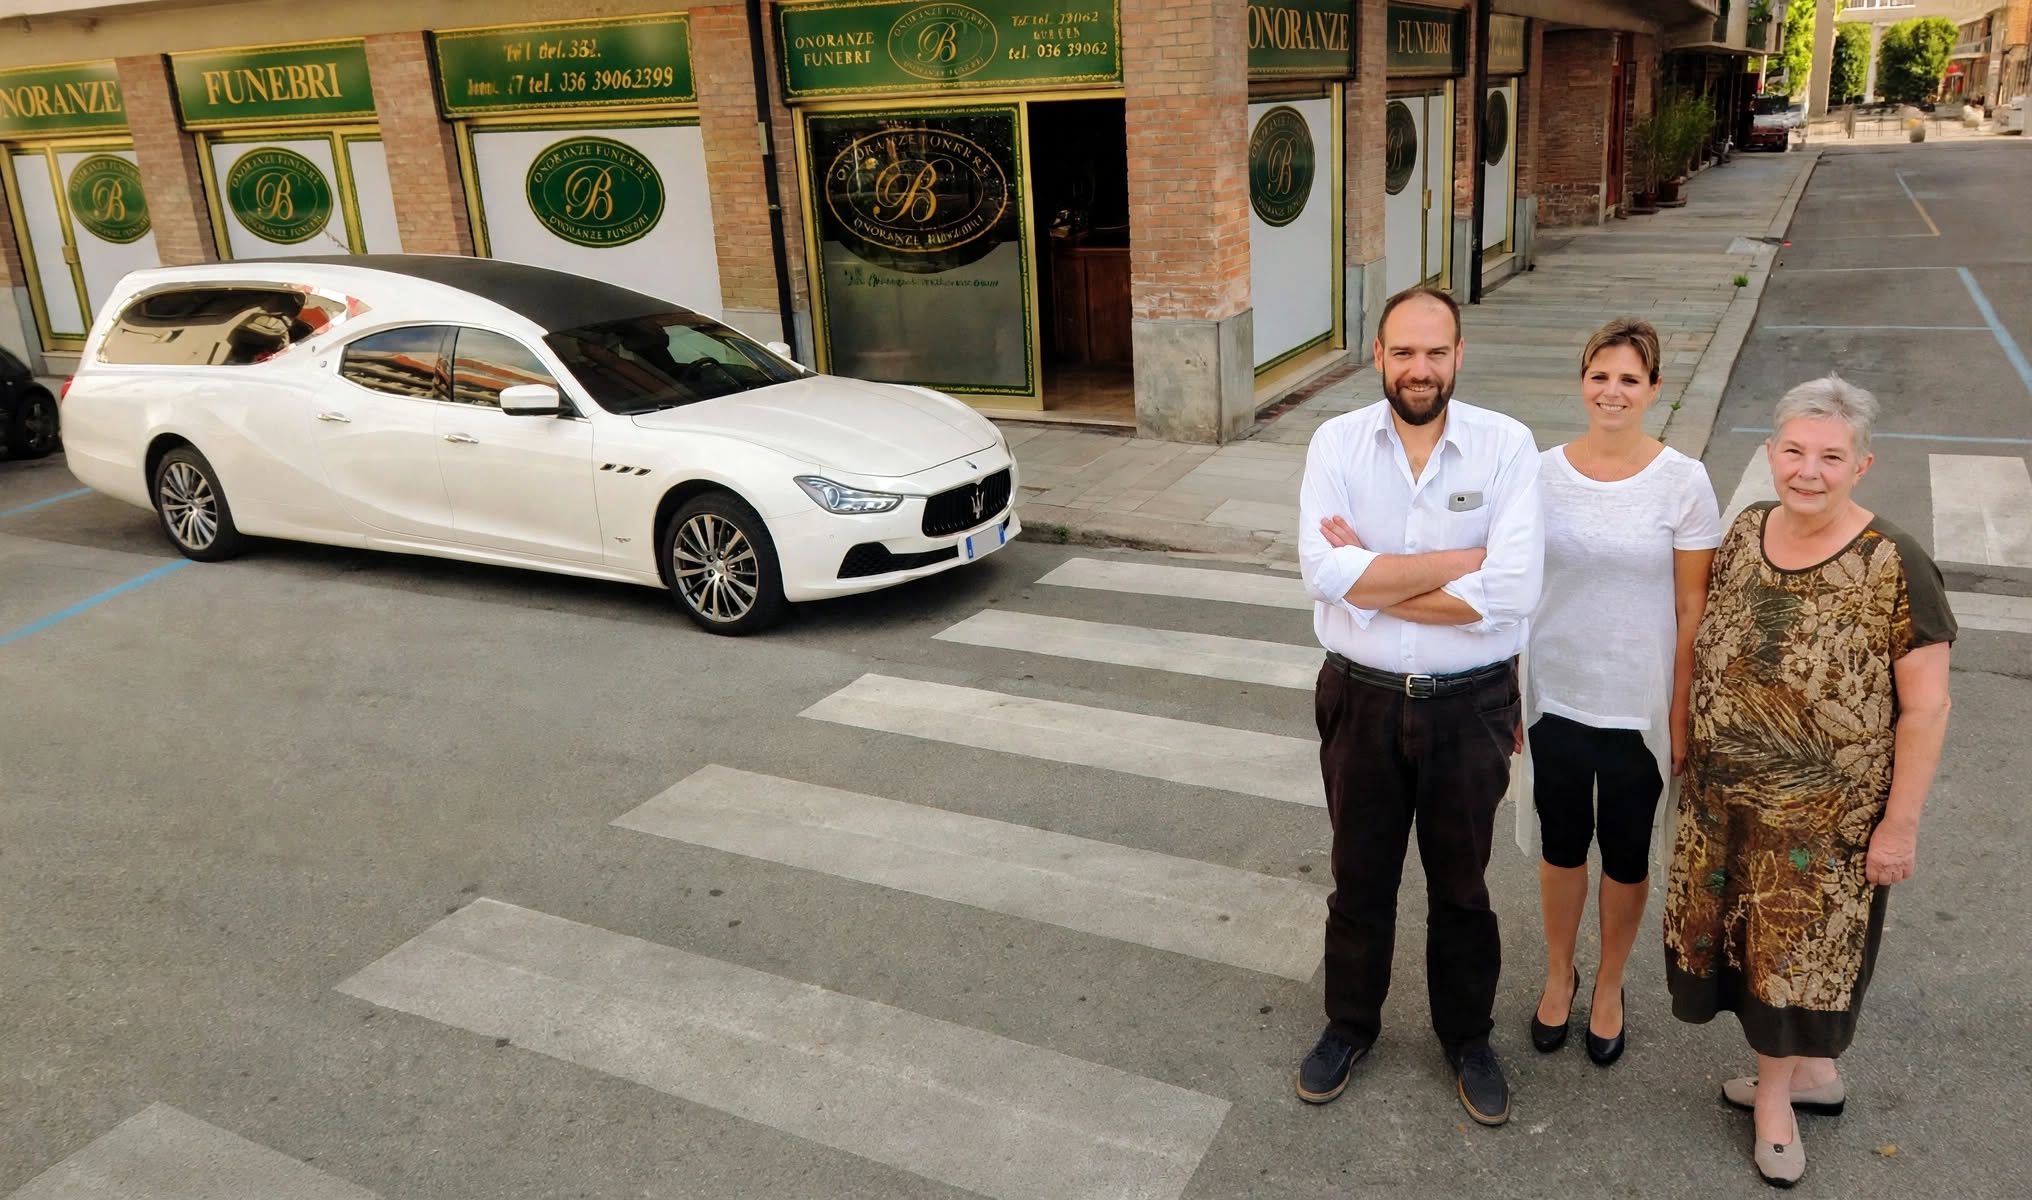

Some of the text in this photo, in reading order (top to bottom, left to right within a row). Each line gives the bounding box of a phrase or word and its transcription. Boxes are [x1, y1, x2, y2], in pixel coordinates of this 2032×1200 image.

[794, 31, 875, 50] ONORANZE
[1247, 5, 1349, 51] ONORANZE
[803, 50, 872, 67] FUNEBRI
[202, 62, 344, 105] FUNEBRI
